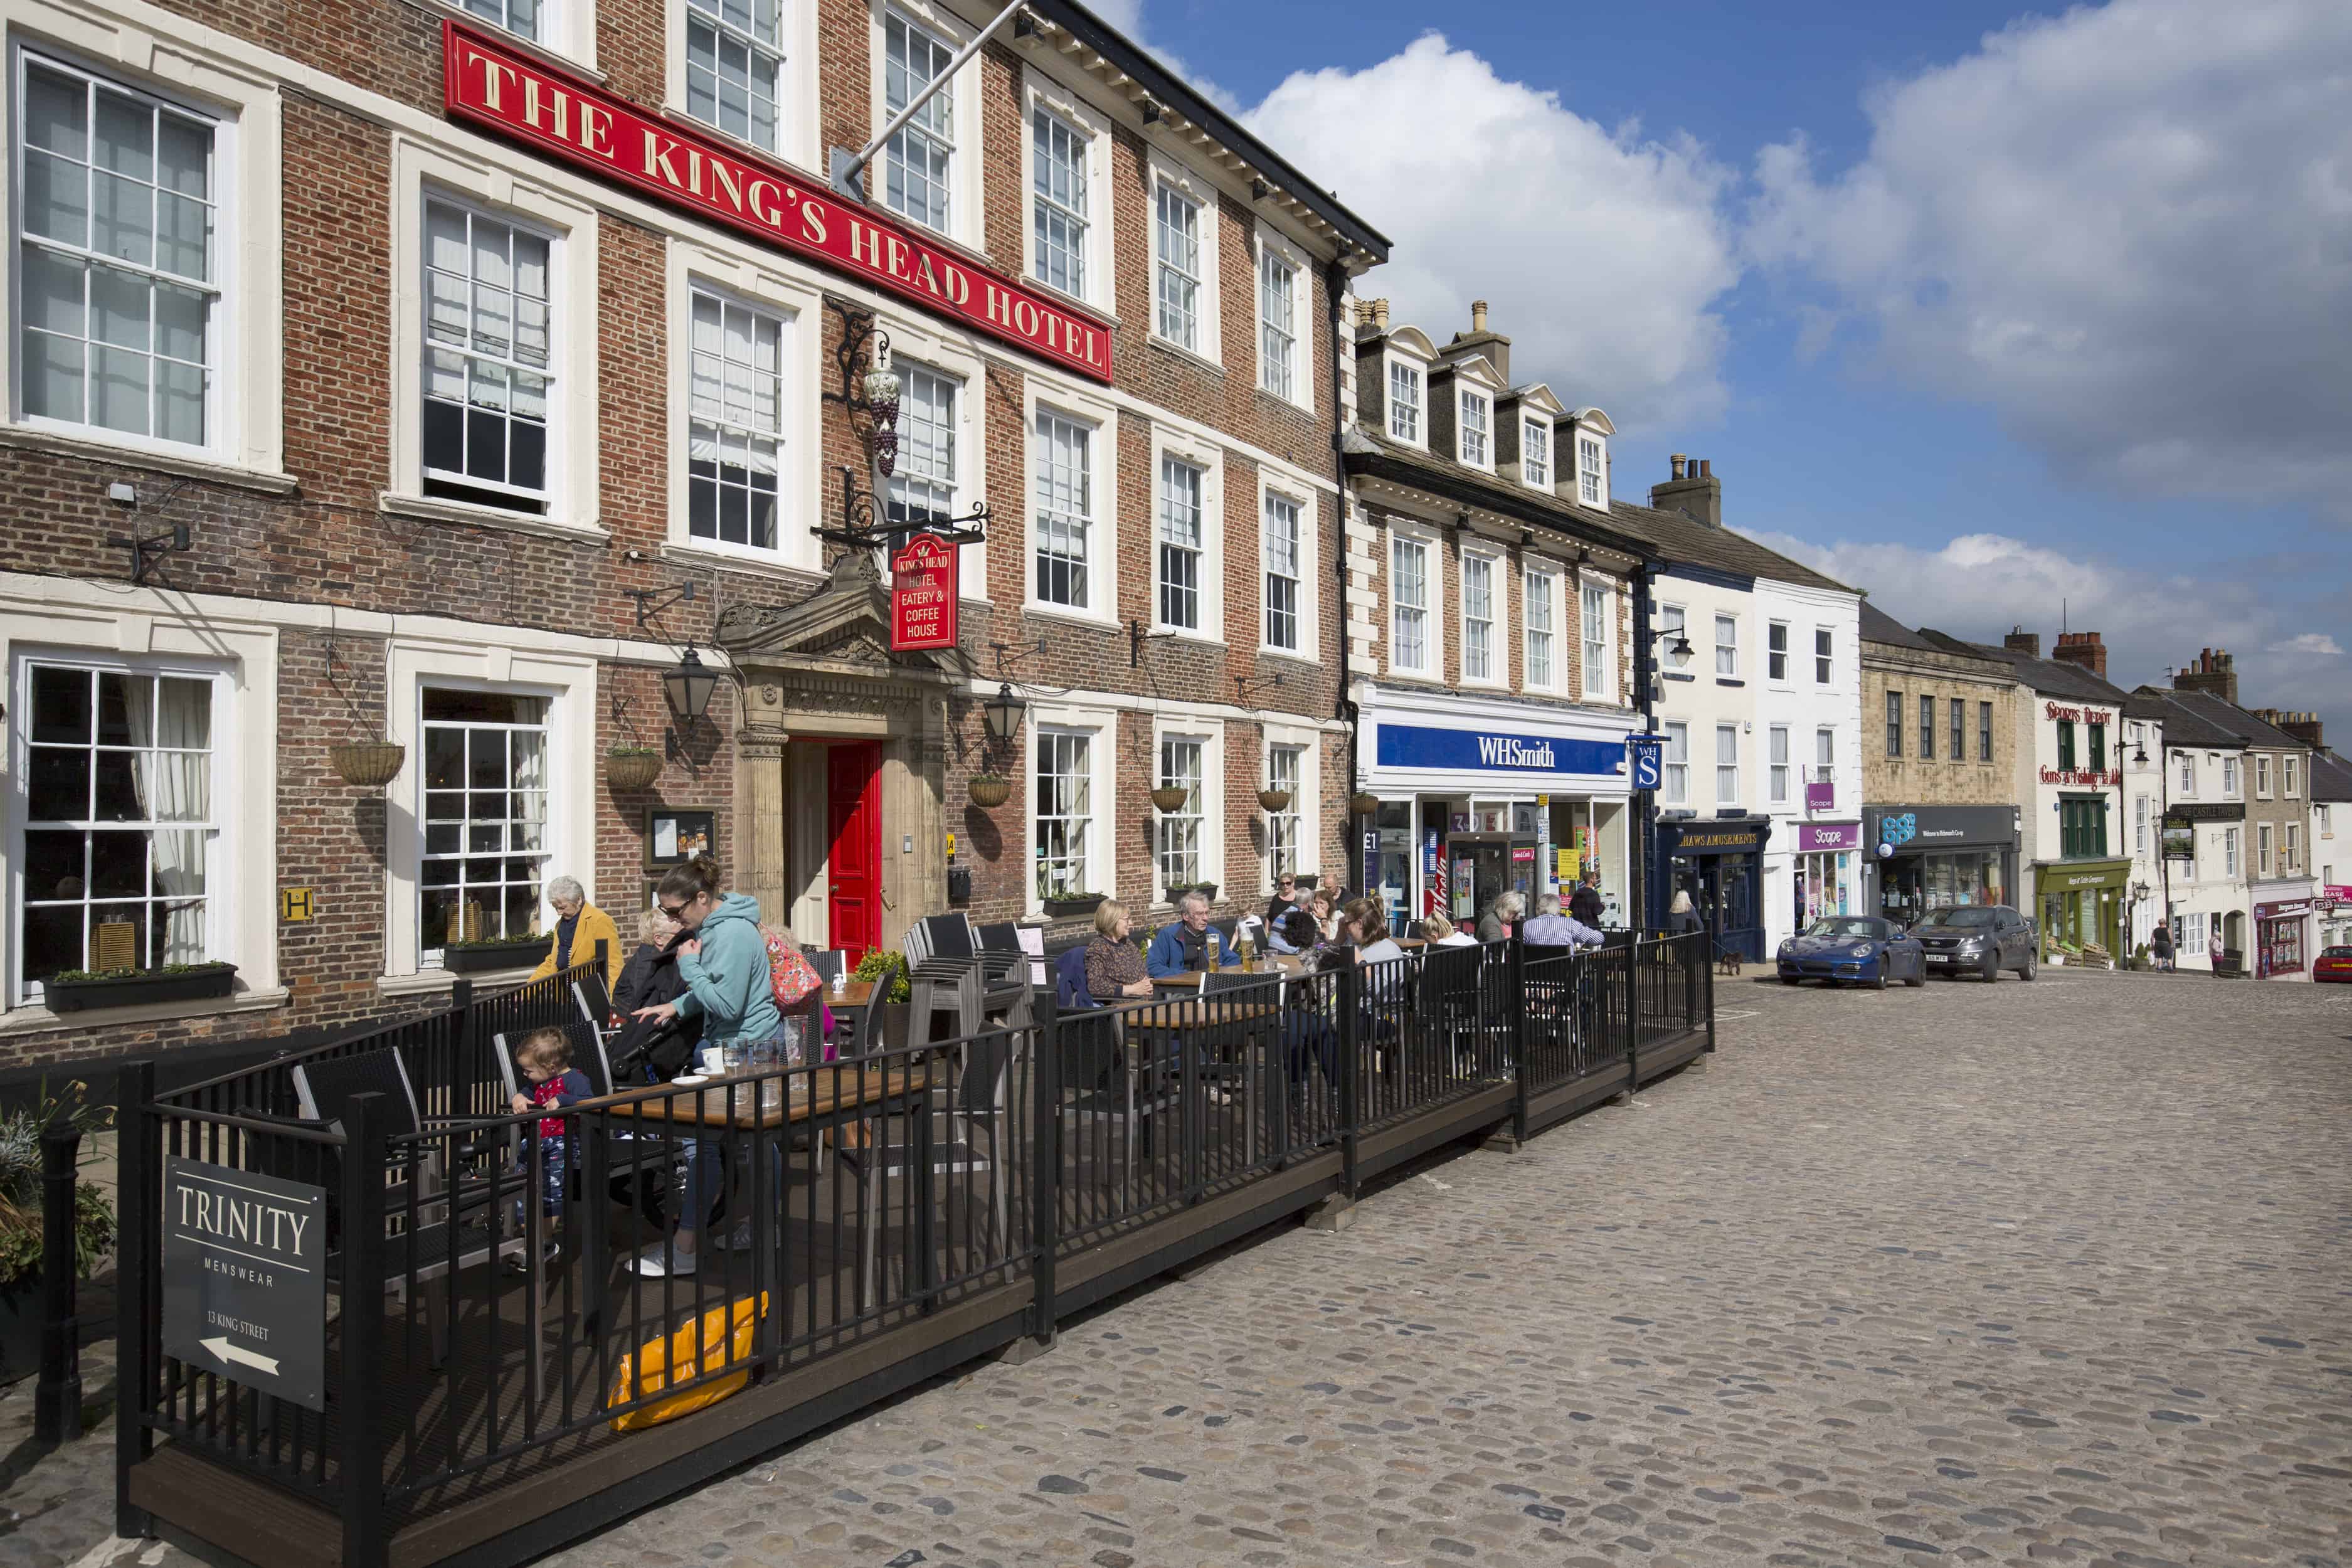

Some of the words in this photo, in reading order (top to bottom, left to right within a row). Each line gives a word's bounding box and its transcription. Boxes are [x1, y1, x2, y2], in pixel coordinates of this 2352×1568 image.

[469, 51, 614, 159] THE
[640, 128, 827, 244] KING'S
[849, 219, 969, 305] HEAD
[985, 283, 1102, 367] HOTEL
[900, 559, 924, 573] KING'S
[926, 556, 948, 568] HEAD
[909, 574, 937, 588] HOTEL
[902, 591, 935, 606] EATERY
[936, 590, 943, 602] &
[906, 607, 939, 622] COFFEE
[908, 623, 938, 638] HOUSE
[1477, 736, 1555, 768] WHSmith
[1639, 747, 1657, 756] WH
[1639, 755, 1658, 785] S
[2040, 765, 2062, 784] Guns
[2193, 807, 2216, 818] CASTLE
[2218, 806, 2240, 817] TAVERN
[1706, 833, 1757, 846] AMUSEMENTS
[1815, 829, 1841, 846] Scope
[287, 892, 309, 917] H
[176, 1184, 309, 1256] TRINITY
[204, 1257, 273, 1288] MENSWEAR
[208, 1310, 216, 1324] 13
[217, 1312, 238, 1332] KING
[240, 1320, 269, 1341] STREET
